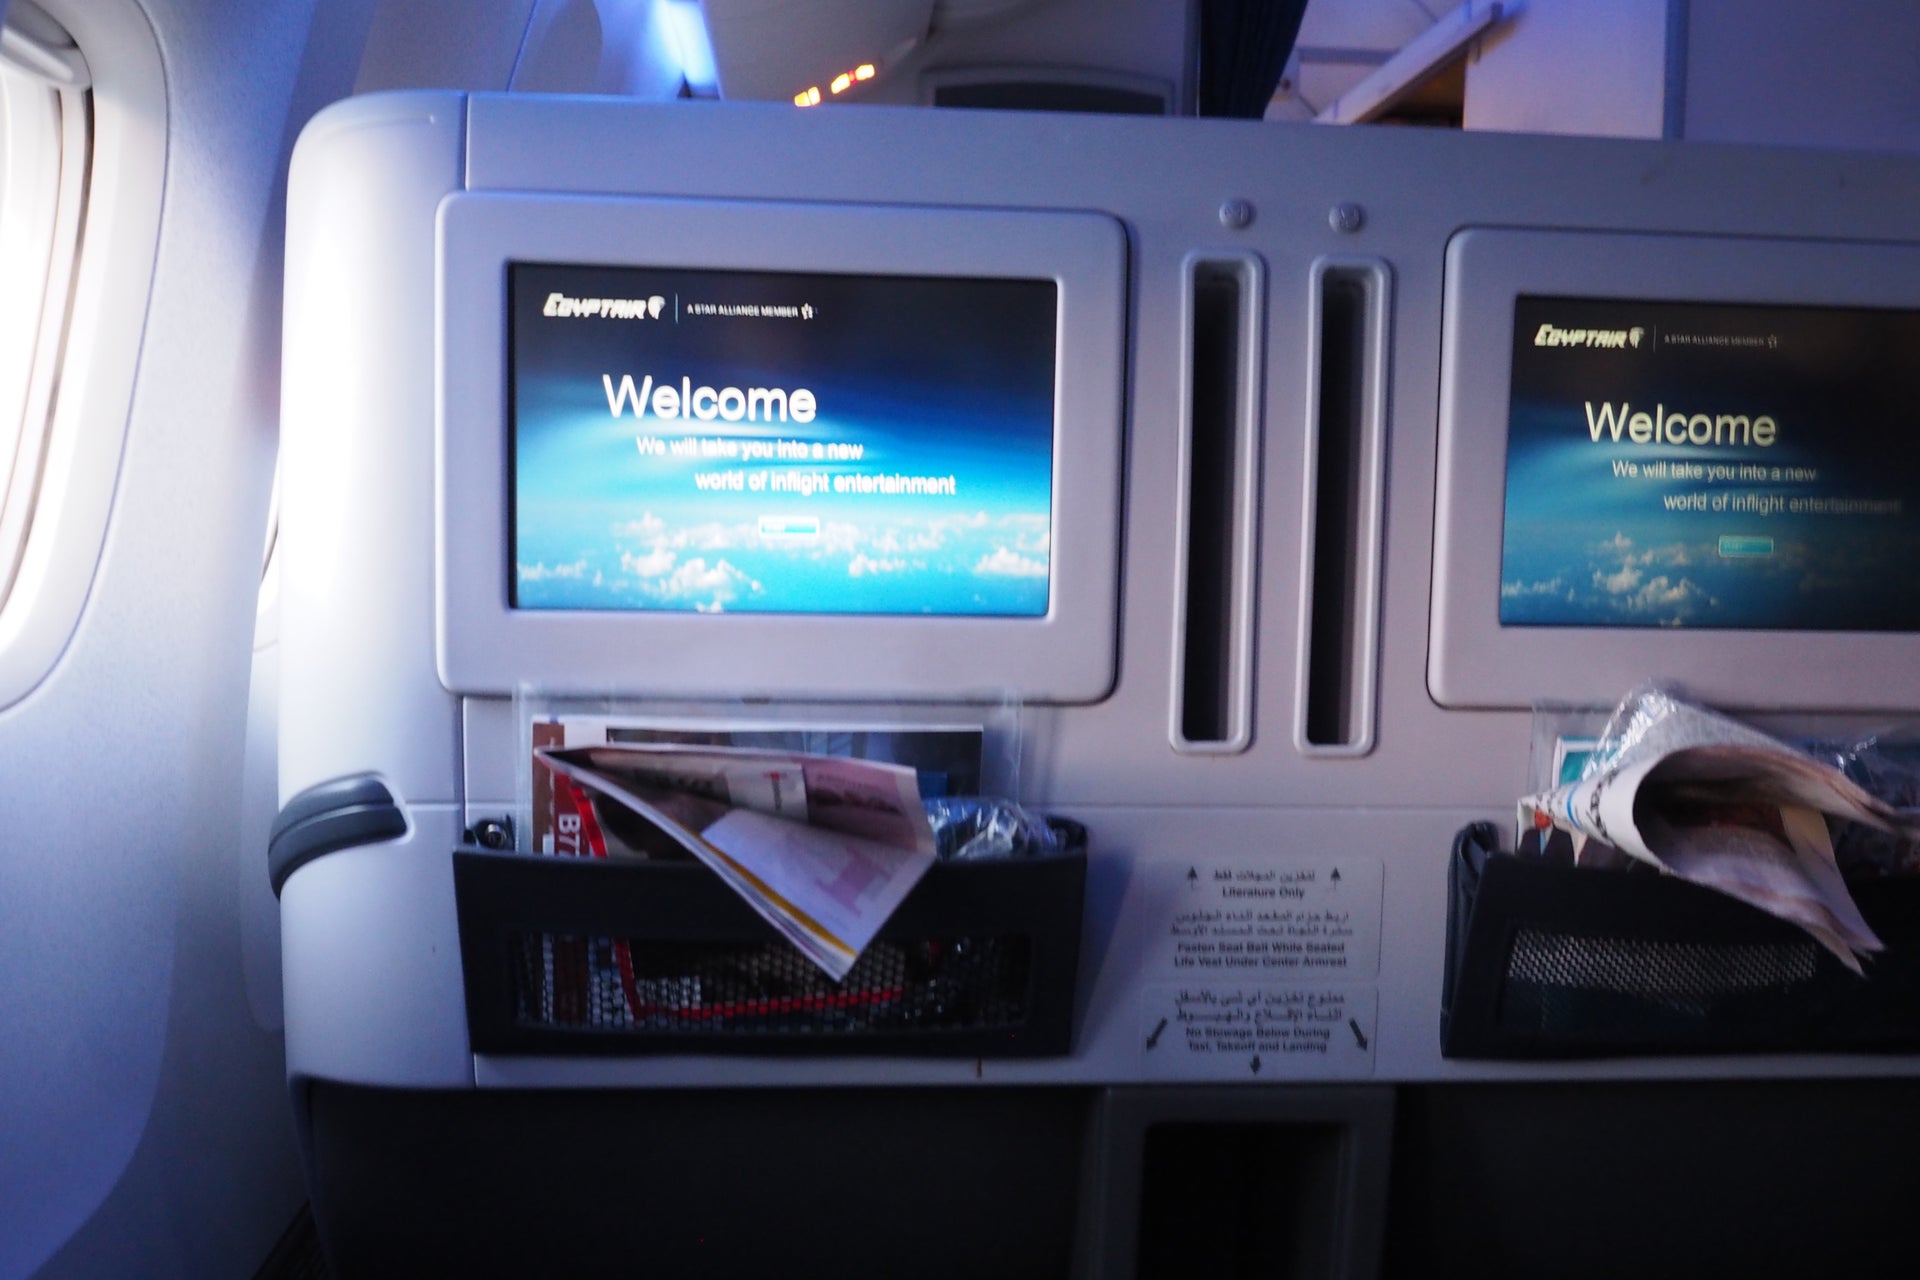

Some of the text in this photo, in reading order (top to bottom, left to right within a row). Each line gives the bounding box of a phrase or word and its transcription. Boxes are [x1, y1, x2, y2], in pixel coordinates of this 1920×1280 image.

[718, 304, 760, 317] ALLIANCE
[761, 305, 799, 318] MEMBER
[602, 373, 817, 424] Welcome
[1584, 401, 1777, 447] Welcome
[636, 436, 864, 461] We will take you into a new
[1612, 459, 1816, 483] We will take you into a new
[694, 470, 956, 496] world of inflight entertainment
[1663, 493, 1901, 516] world of inflight entertainment
[1222, 886, 1305, 899] Literature Only
[1178, 942, 1345, 953] Fasten Seat Belt While Seated
[1174, 956, 1347, 968] Life Vest Under Center Armrest
[1186, 1026, 1331, 1040] No Stowage Below During
[1217, 1041, 1256, 1052] Takeoff
[1258, 1041, 1280, 1052] and
[1282, 1042, 1327, 1054] Landing
